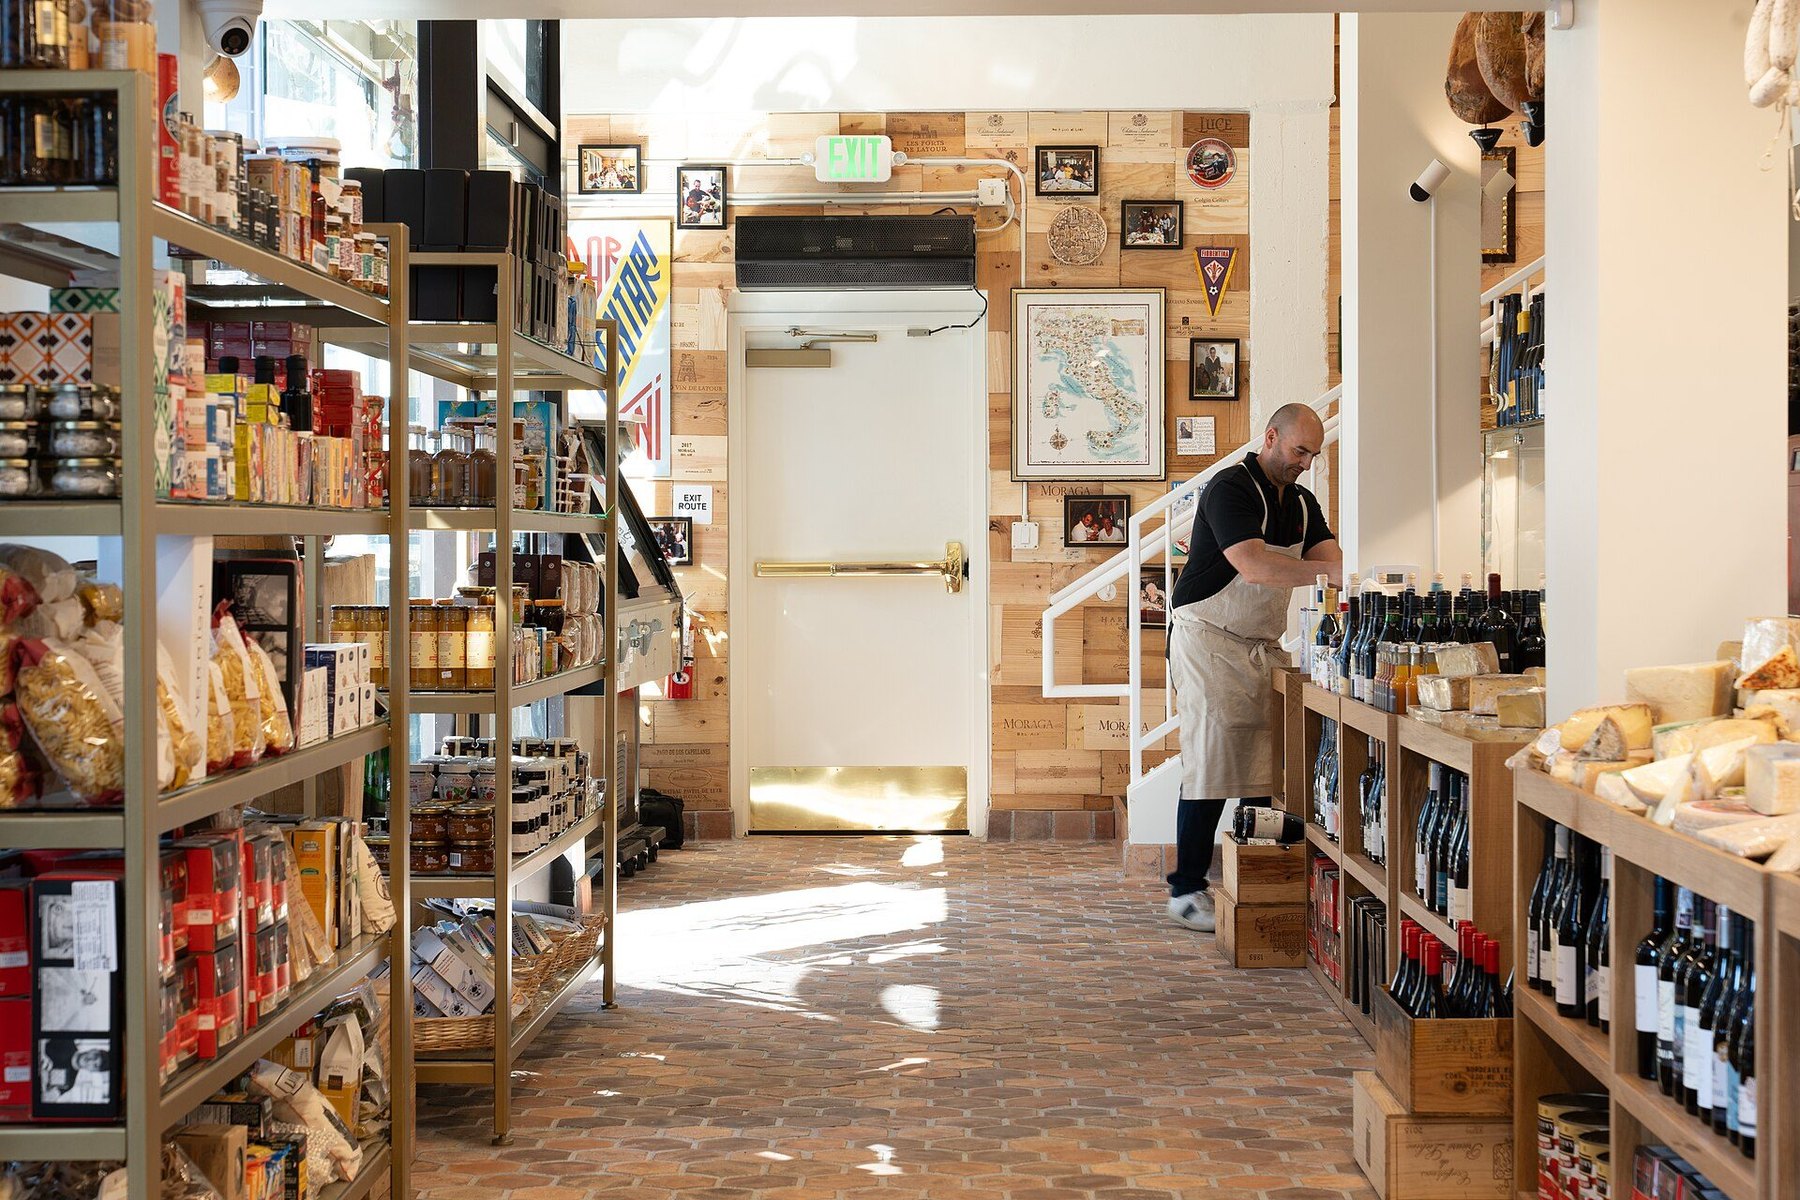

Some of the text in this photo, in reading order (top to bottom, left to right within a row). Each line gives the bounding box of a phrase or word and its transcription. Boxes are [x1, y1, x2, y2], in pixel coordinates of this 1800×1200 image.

[1199, 117, 1233, 133] LUCE
[921, 139, 945, 147] FORTS
[829, 138, 882, 179] EXIT
[1041, 485, 1091, 497] MORAGA
[684, 494, 702, 502] EXIT
[678, 502, 707, 511] ROUTE
[1003, 718, 1054, 730] MORAGA
